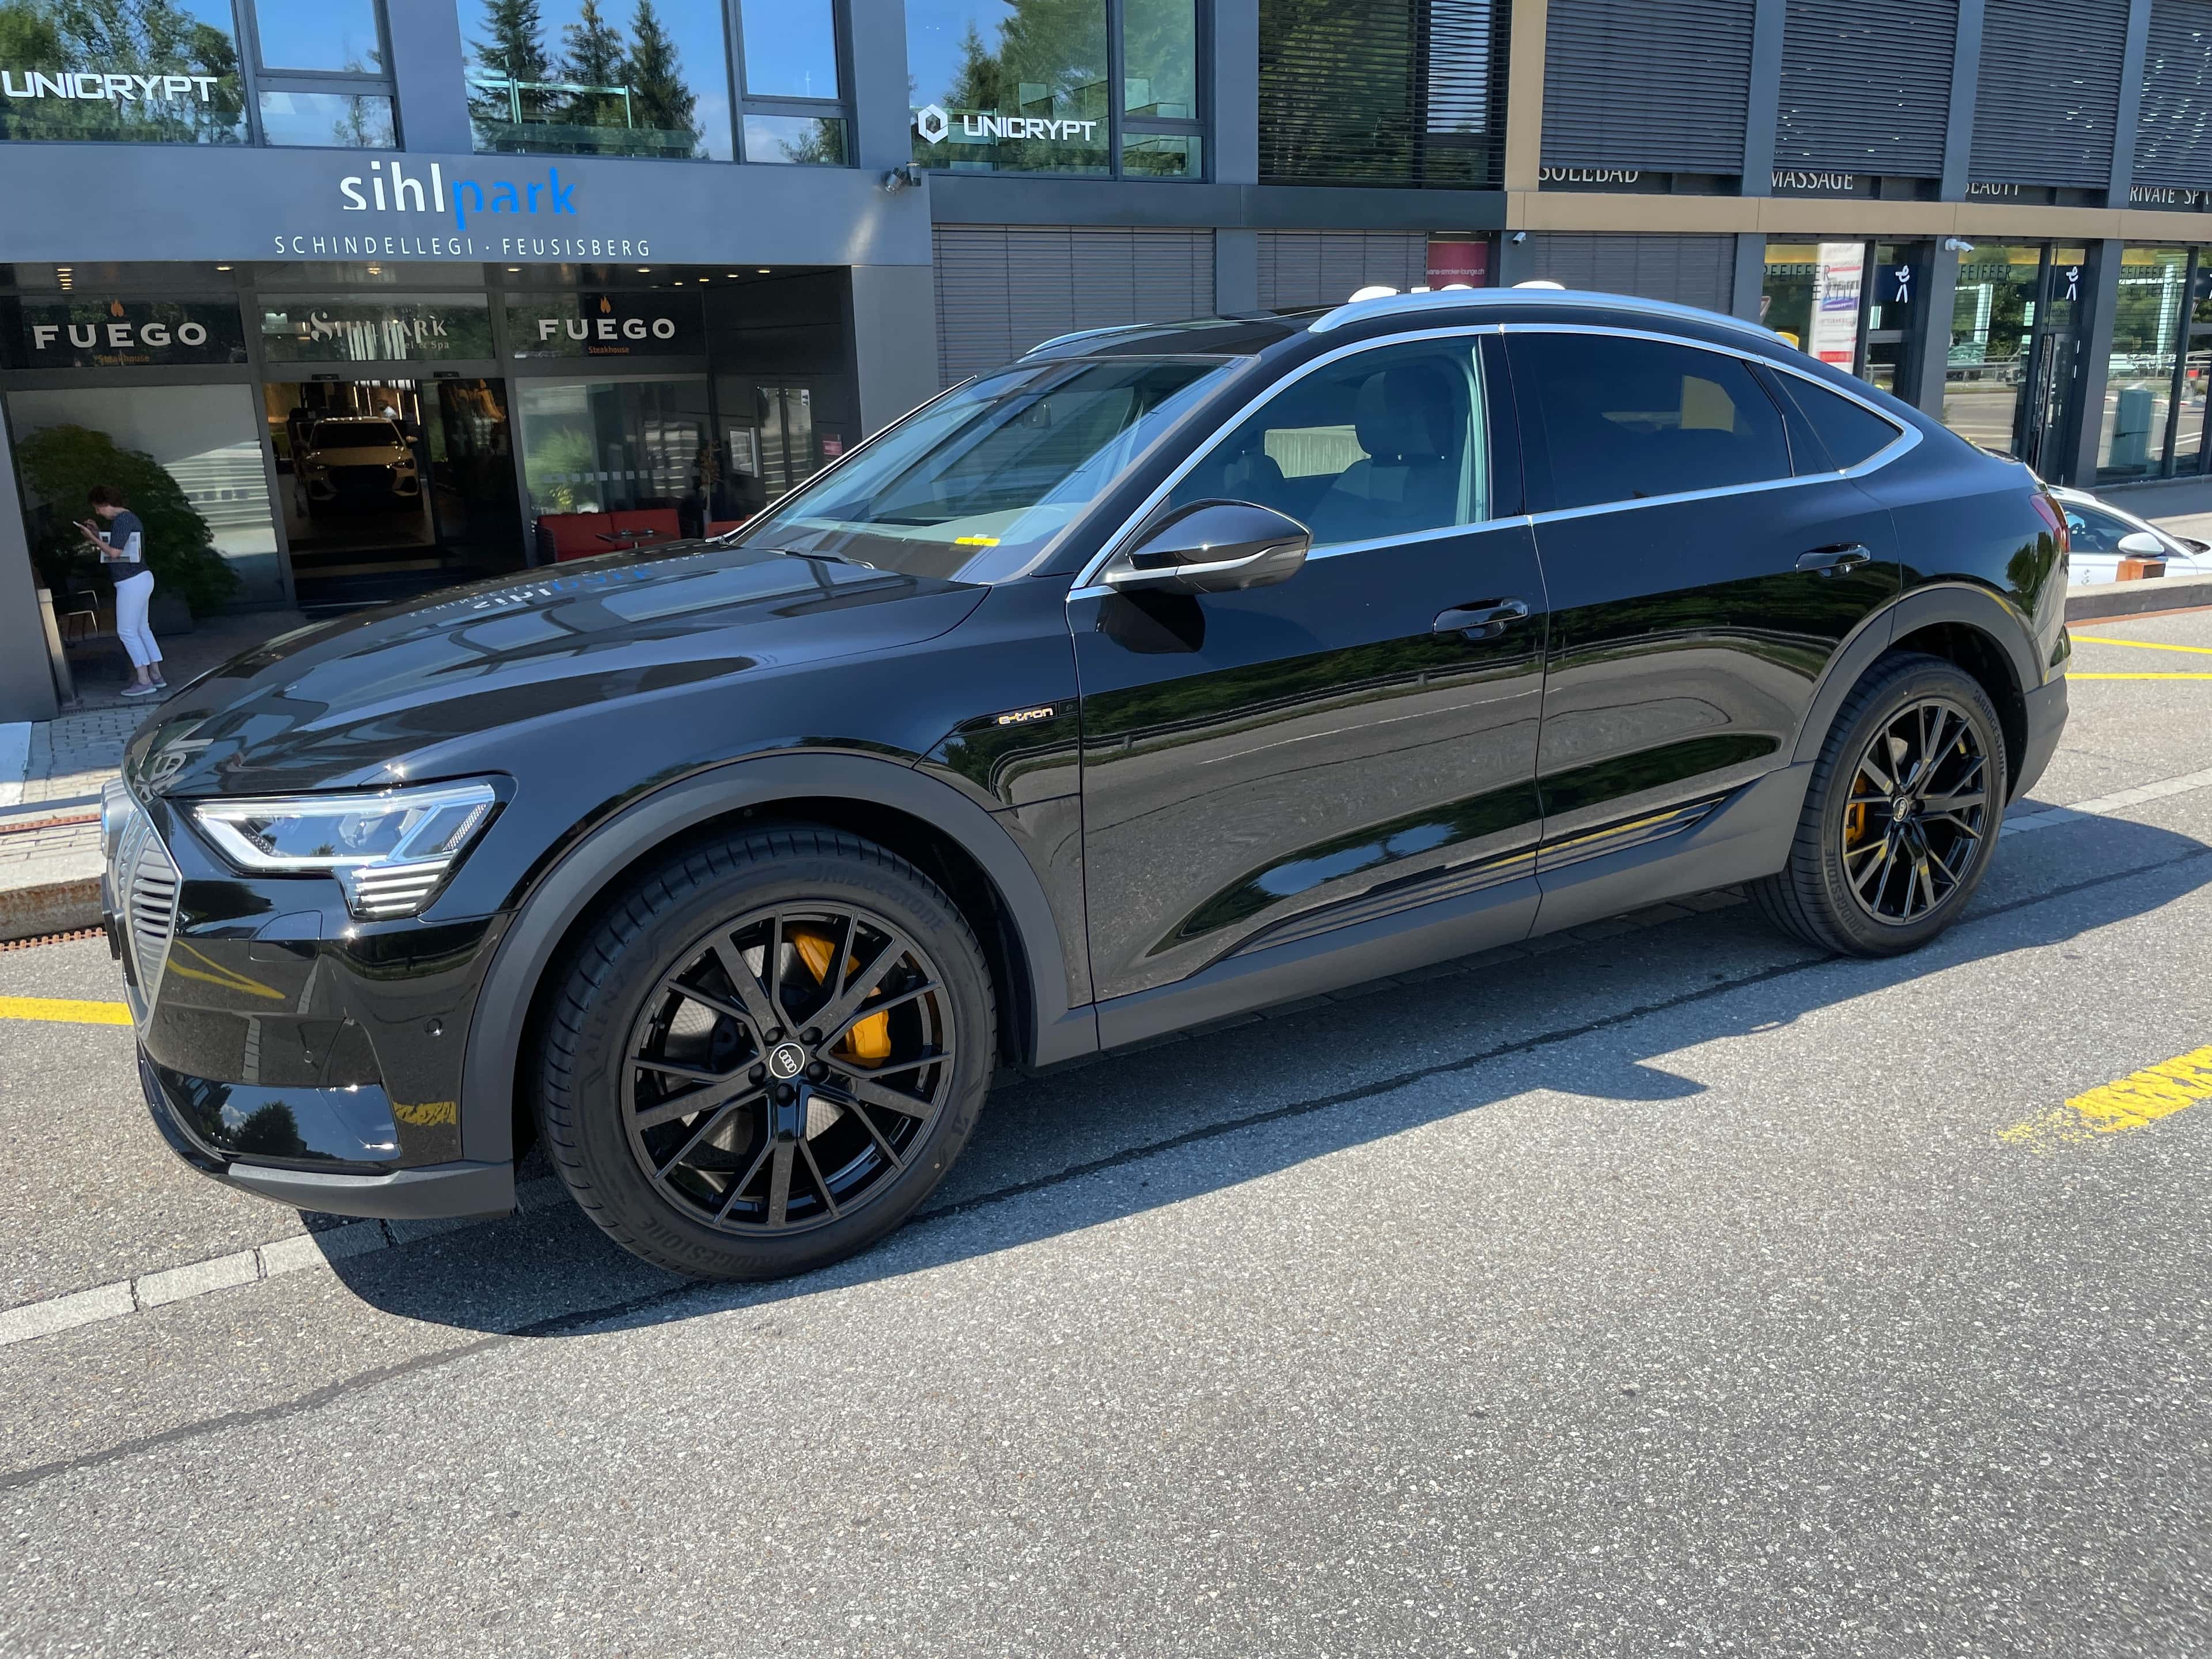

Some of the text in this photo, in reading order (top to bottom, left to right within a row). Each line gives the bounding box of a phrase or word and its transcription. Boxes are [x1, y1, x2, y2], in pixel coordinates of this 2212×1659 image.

[2, 70, 218, 103] UNICRYPT
[963, 115, 1097, 142] UNICRYPT
[340, 161, 577, 231] sihlpark
[1965, 182, 2019, 196] EAUT
[2130, 186, 2176, 204] RIVATE
[275, 236, 650, 258] SCHINDELLEGI FEUSISBERG
[1427, 267, 1485, 276] vana-smoker-lounge.ch
[1960, 264, 2012, 282] FEIFFER
[1812, 283, 1854, 301] EXTIL
[32, 321, 208, 350] FUEGO
[537, 318, 676, 341] FUEGO
[431, 340, 450, 351] Spa
[588, 346, 630, 354] Steakhouse
[998, 707, 1054, 725] e-tron
